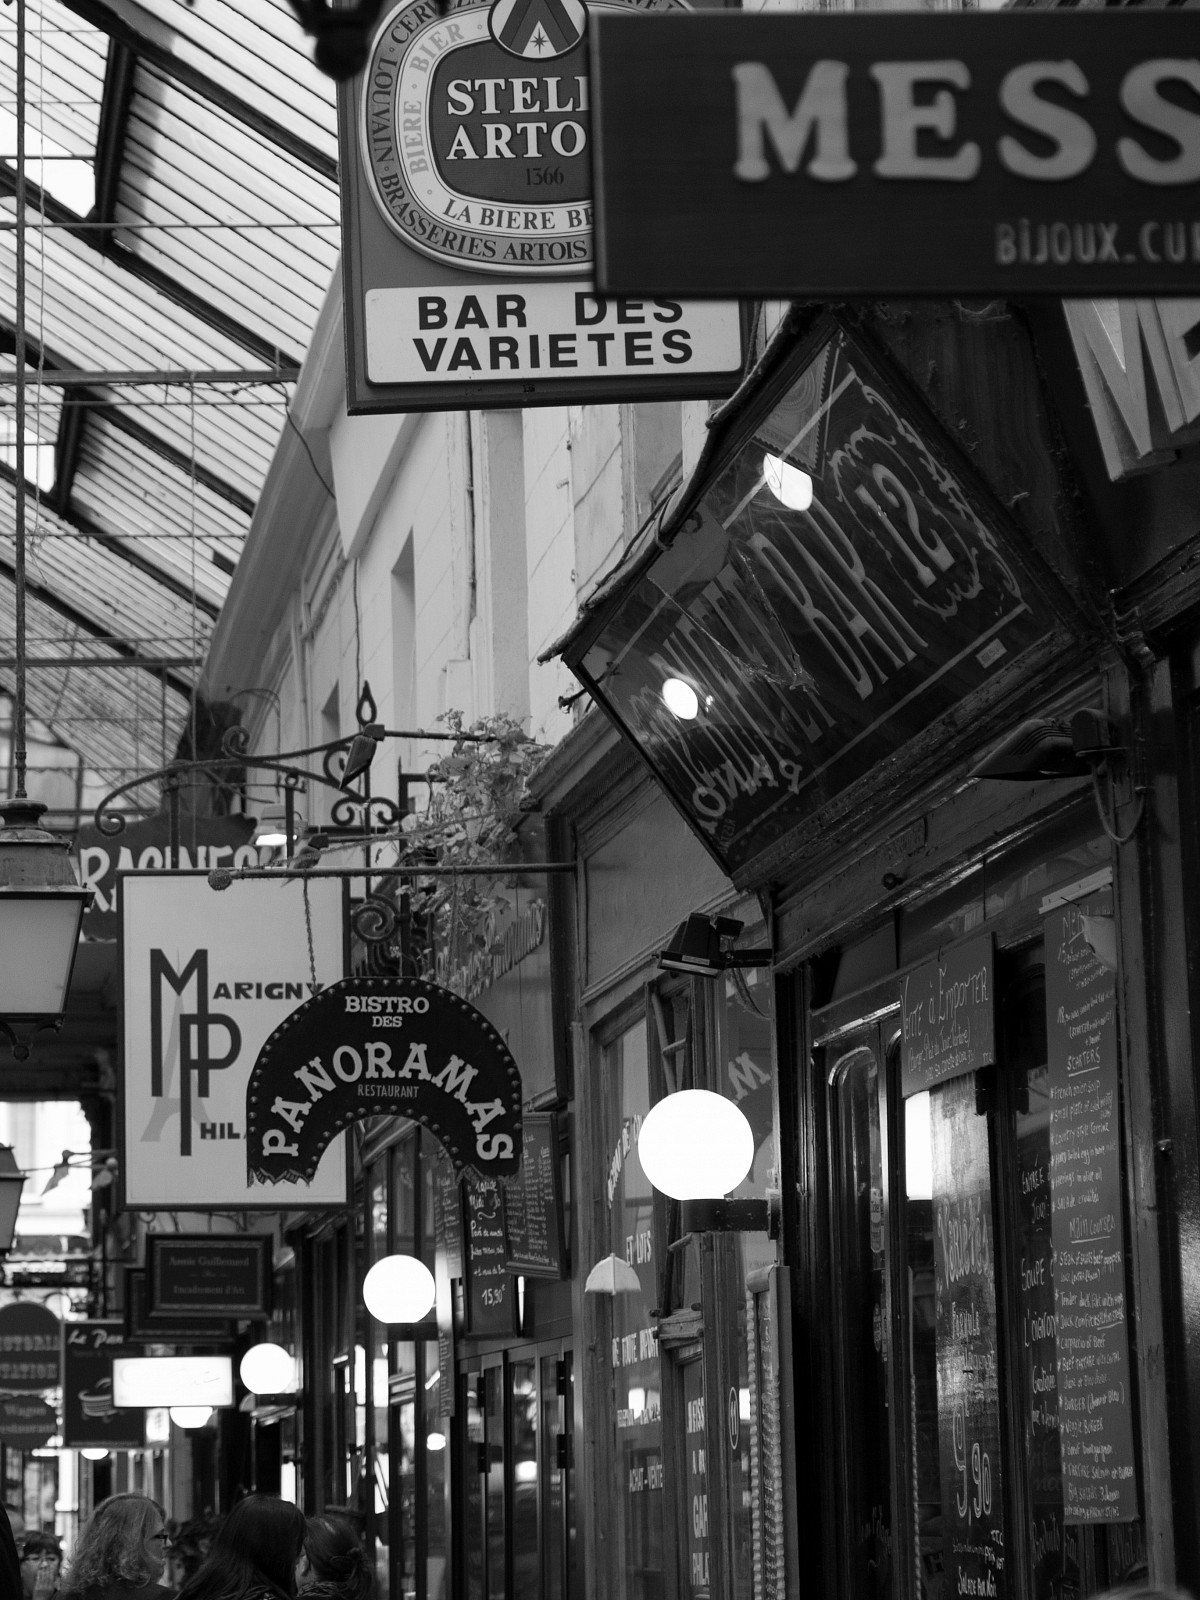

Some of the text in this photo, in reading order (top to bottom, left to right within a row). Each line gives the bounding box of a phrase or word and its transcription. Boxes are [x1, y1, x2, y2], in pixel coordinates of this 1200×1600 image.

[408, 21, 465, 74] BIER
[369, 55, 398, 165] LOUVAIN
[730, 58, 1200, 186] MESS
[402, 98, 431, 177] BIERE
[525, 165, 566, 187] 1366
[378, 171, 589, 263] BRASSERIES ARTOIS
[441, 197, 473, 225] LA
[478, 207, 557, 232] BIERE
[416, 292, 685, 331] BAR DES
[411, 328, 695, 373] VARIETES
[849, 454, 962, 591] 12
[746, 476, 932, 702] BAR
[344, 994, 430, 1015] BISTRO
[371, 1015, 404, 1029] DES
[261, 1041, 515, 1161] PANORAMAS
[356, 1083, 420, 1100] RESTAURANT
